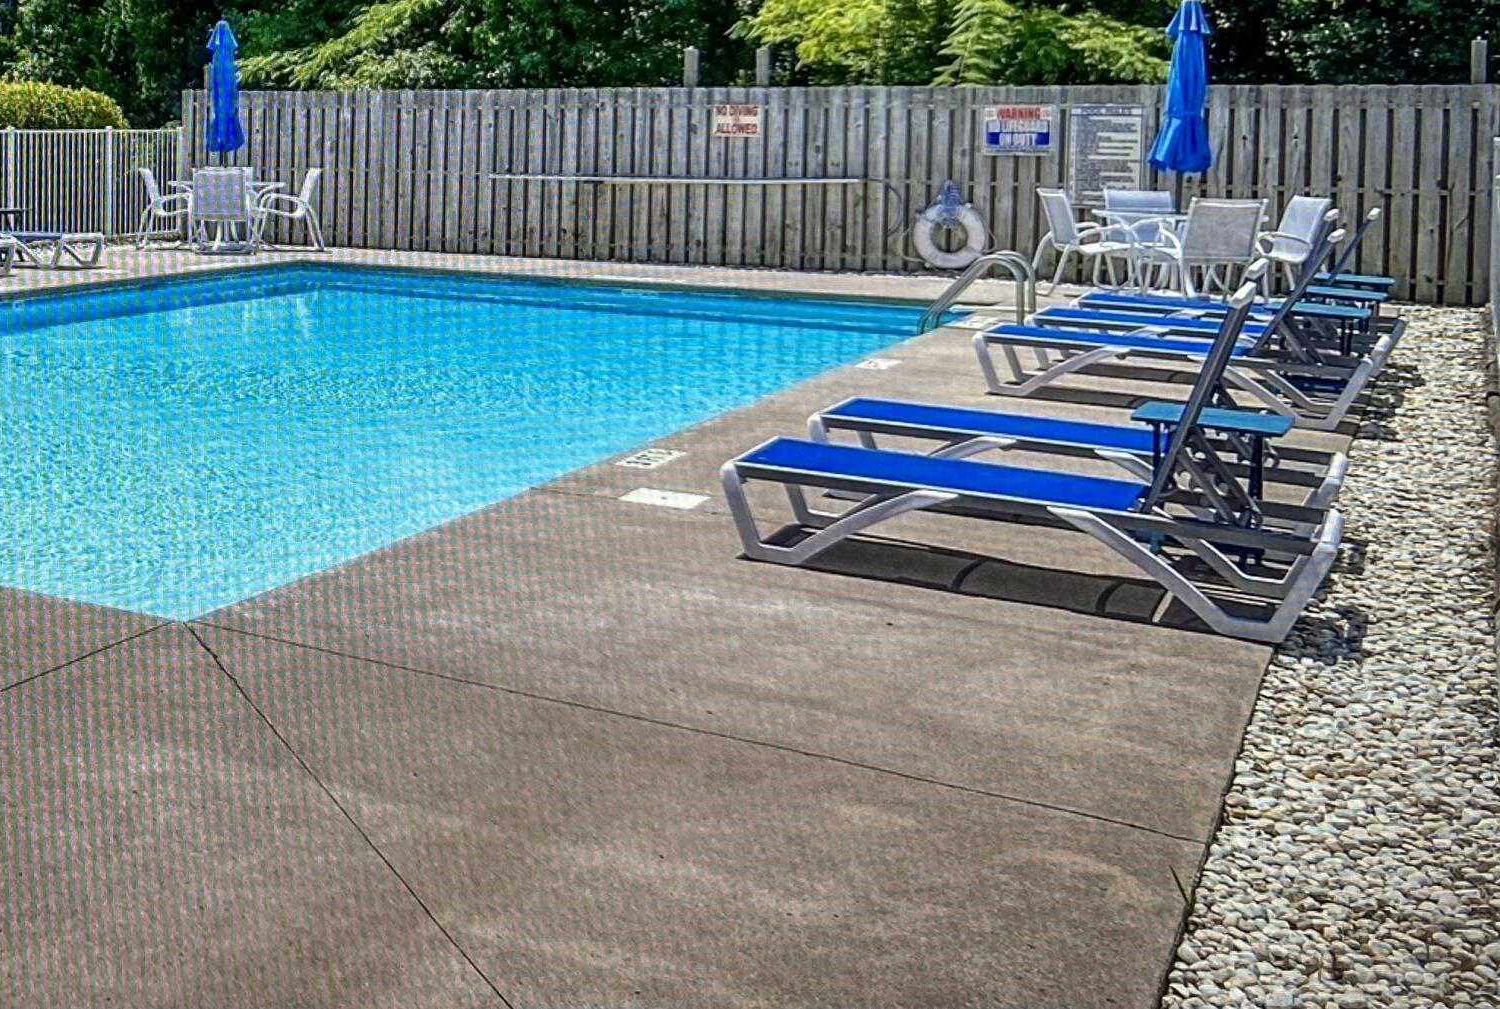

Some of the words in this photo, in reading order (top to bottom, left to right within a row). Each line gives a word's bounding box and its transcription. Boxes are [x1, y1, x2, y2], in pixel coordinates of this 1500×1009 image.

[716, 105, 727, 116] NO
[729, 105, 757, 116] DIVING
[997, 107, 1041, 120] WARNING
[716, 123, 757, 134] ALLOWED
